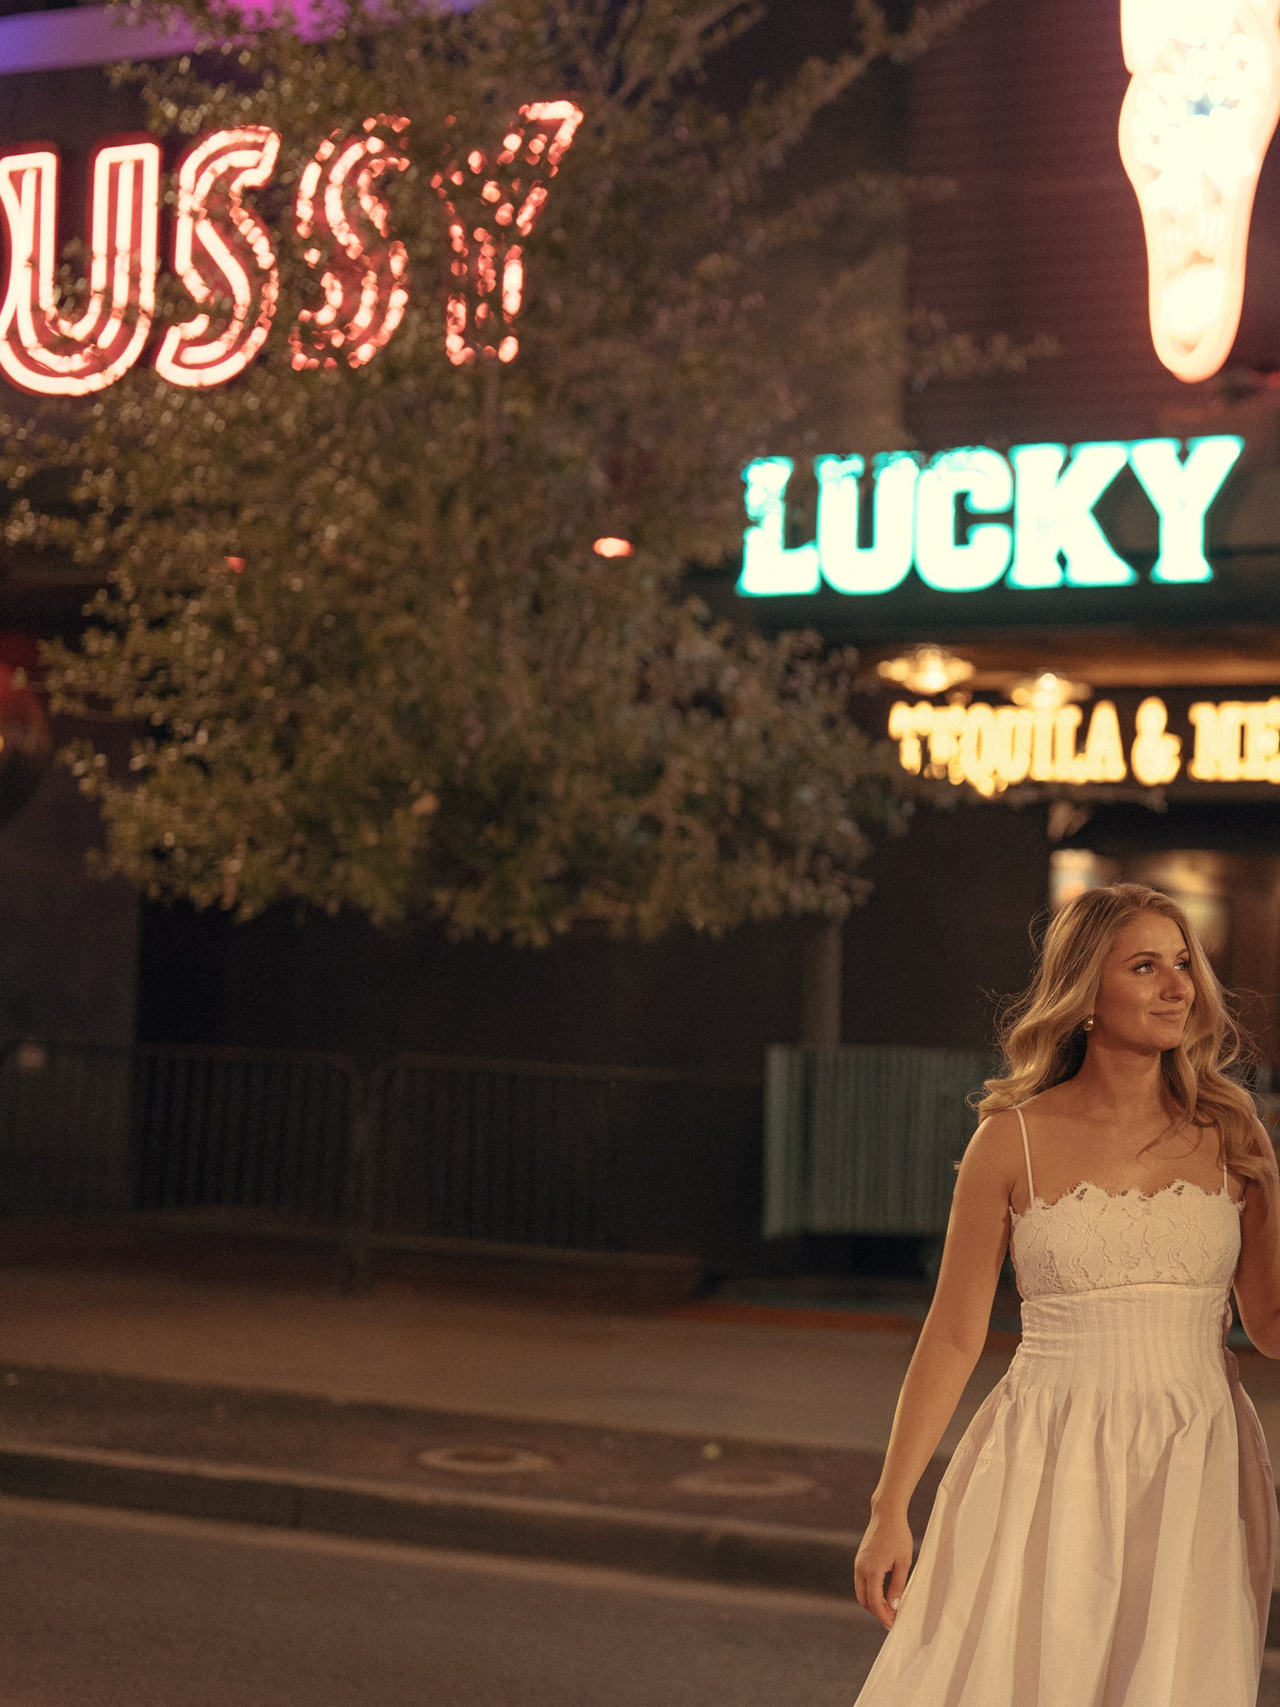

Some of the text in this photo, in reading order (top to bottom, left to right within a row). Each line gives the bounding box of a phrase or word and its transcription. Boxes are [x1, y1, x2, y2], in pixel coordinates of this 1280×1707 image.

[0, 100, 585, 397] USSY
[737, 433, 1244, 597] LUCKY
[1131, 696, 1183, 786] &
